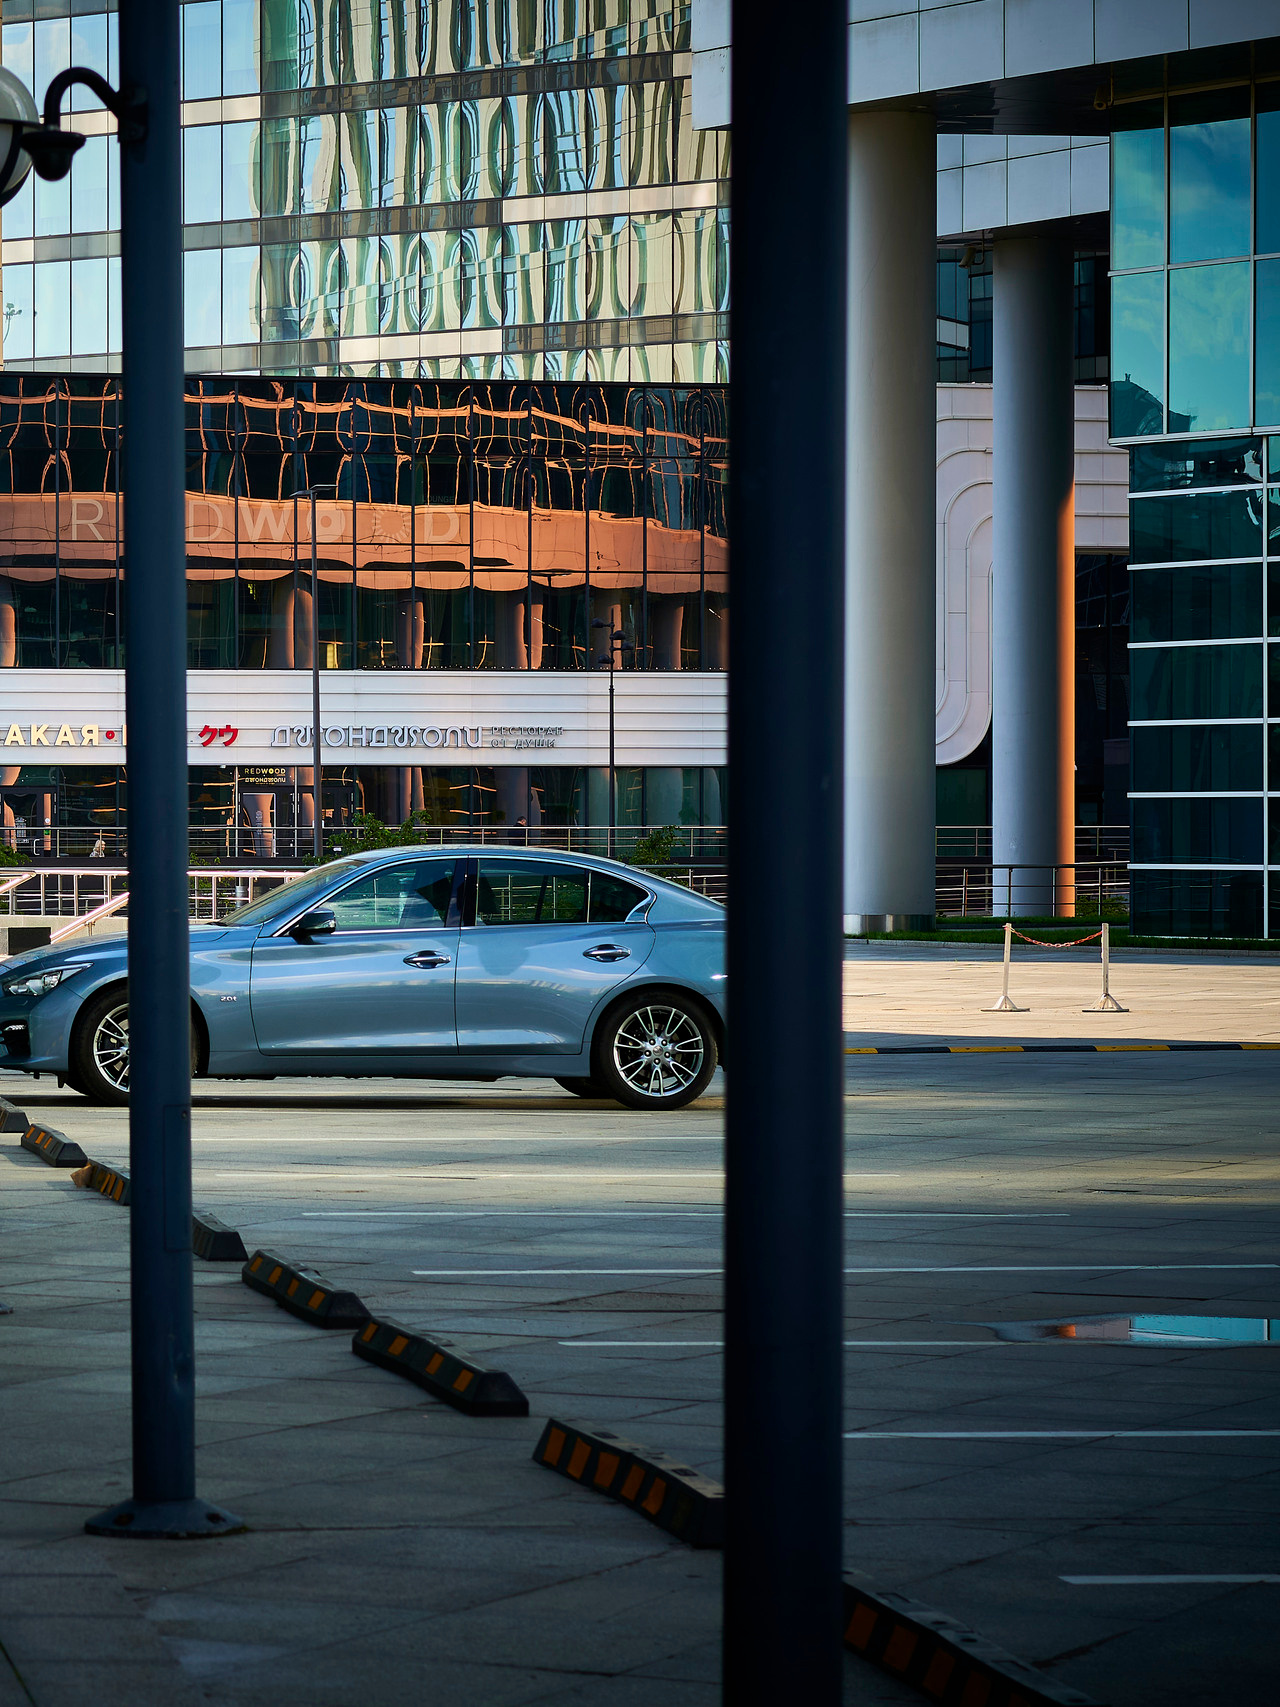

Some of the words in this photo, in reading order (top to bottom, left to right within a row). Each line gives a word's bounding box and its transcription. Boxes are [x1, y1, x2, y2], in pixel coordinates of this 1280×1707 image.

[71, 498, 460, 543] RDWOOD
[491, 726, 563, 735] РЕСТОРАН
[515, 739, 556, 749] ДУШИ
